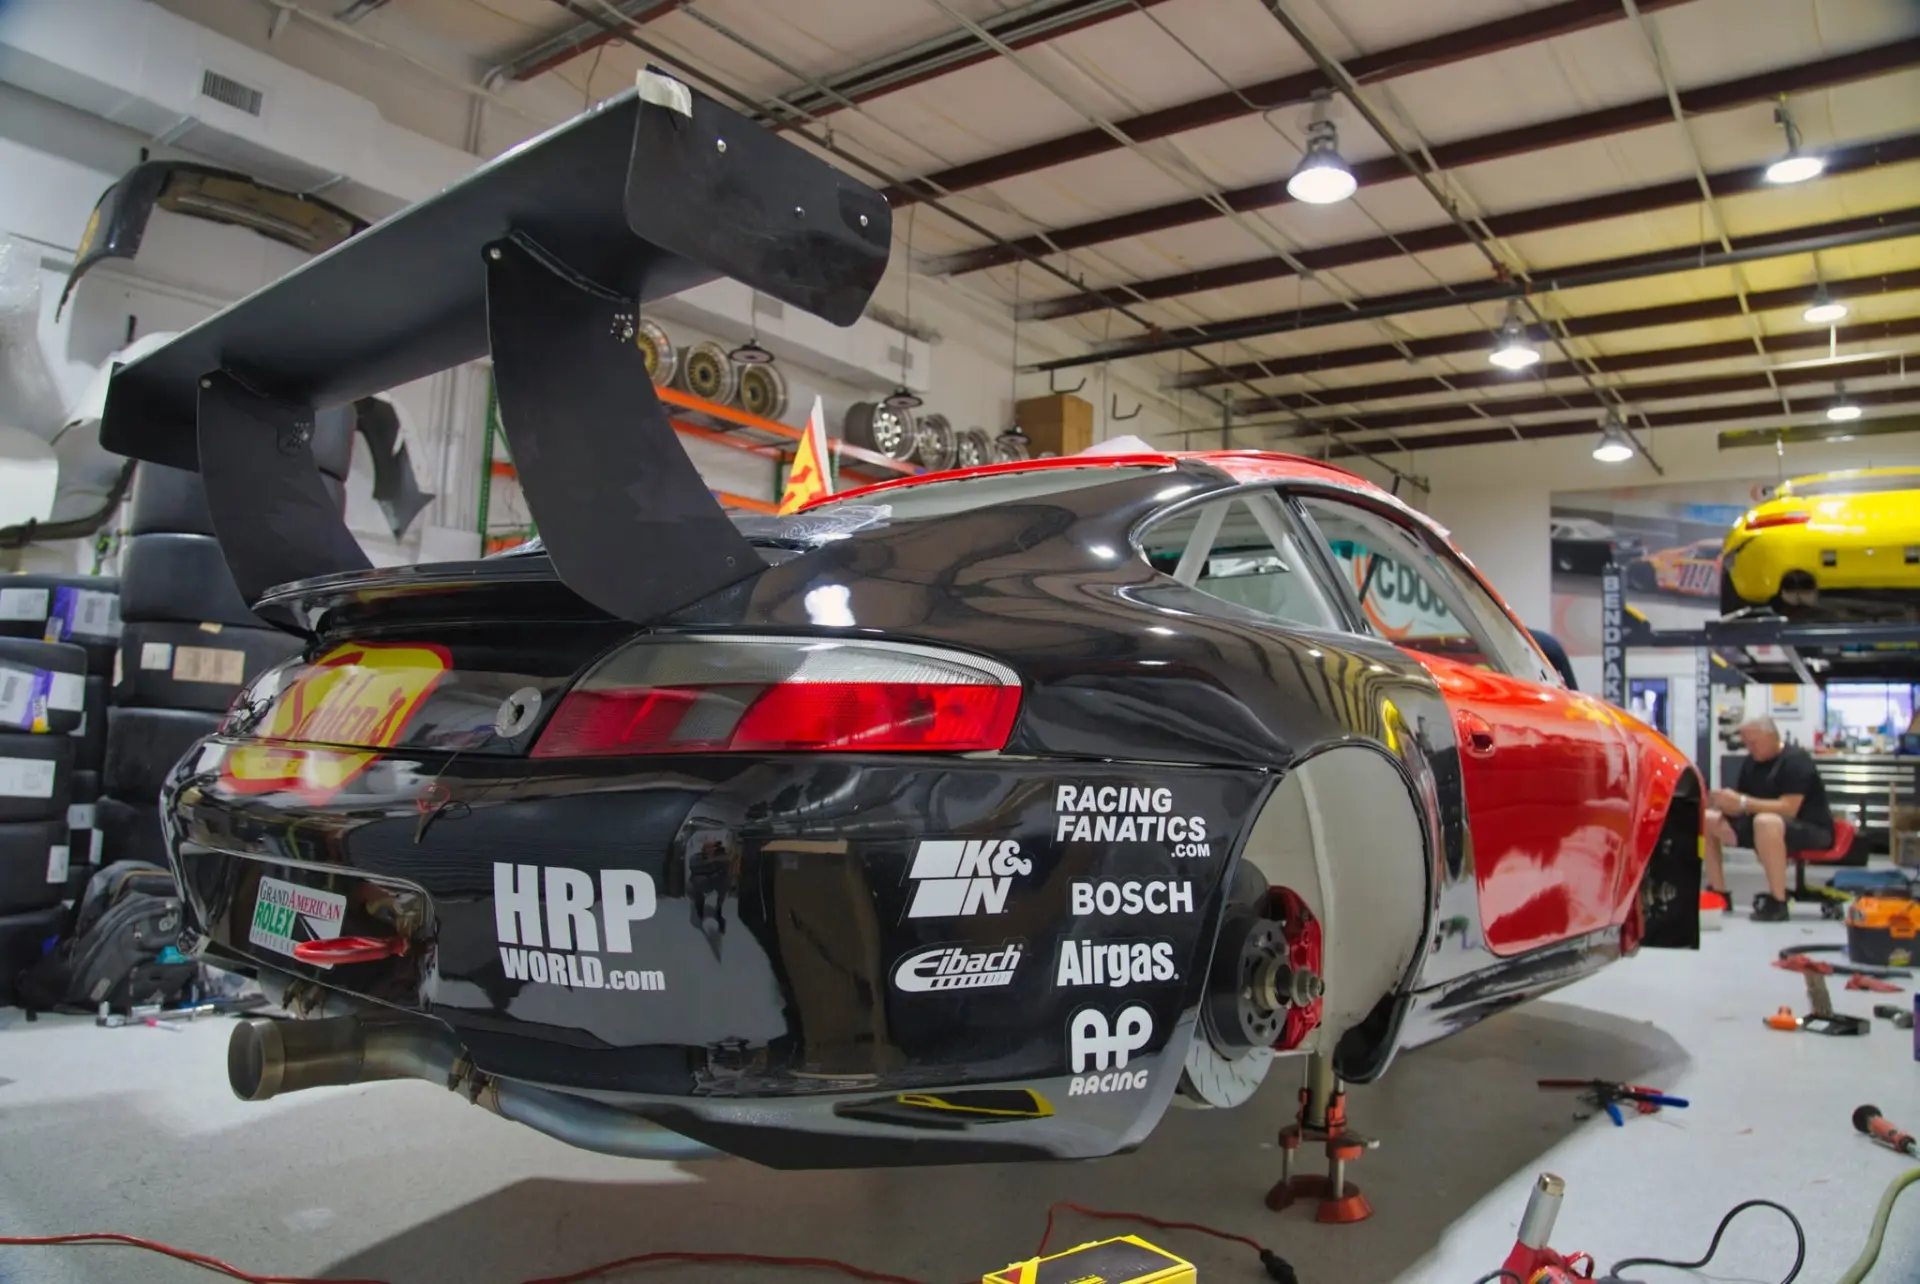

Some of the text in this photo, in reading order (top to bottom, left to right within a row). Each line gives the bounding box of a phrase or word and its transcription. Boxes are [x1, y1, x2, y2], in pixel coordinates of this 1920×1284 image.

[1056, 785, 1172, 813] RACING
[1056, 815, 1206, 842] FANATICS
[1171, 844, 1210, 857] .COM
[494, 862, 657, 953] HRP
[1072, 881, 1193, 915] BOSCH
[254, 901, 295, 938] ROLEX
[499, 947, 666, 990] WORLD.com
[895, 944, 1021, 992] Eibach
[1057, 940, 1176, 987] Airgas
[1071, 1006, 1153, 1074] AP
[1068, 1070, 1149, 1097] RACING
